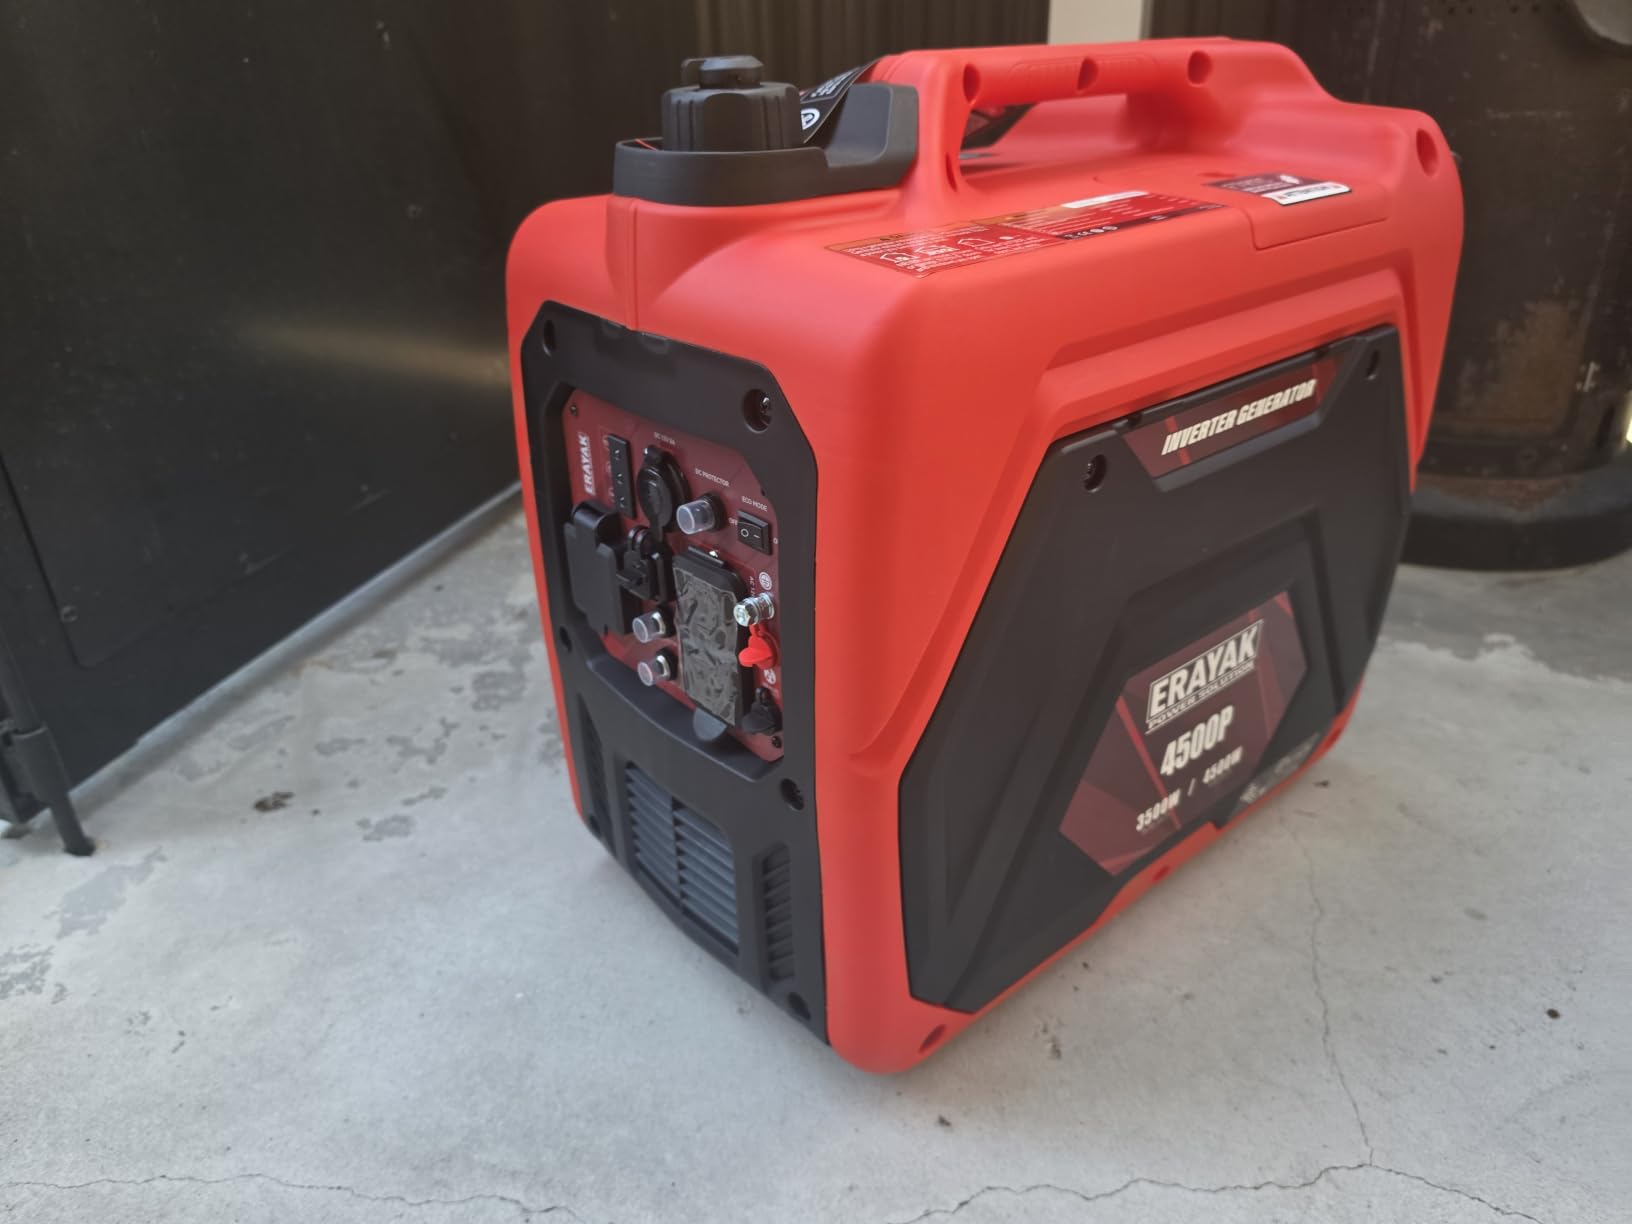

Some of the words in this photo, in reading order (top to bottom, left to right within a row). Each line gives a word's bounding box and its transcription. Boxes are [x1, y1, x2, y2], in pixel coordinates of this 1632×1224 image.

[1161, 409, 1238, 455] INVERTER
[1237, 379, 1318, 425] GENERATOR
[578, 432, 595, 495] ERAYAK
[702, 472, 730, 487] PROTECTOR
[742, 496, 752, 505] ECO
[752, 500, 768, 512] MODE
[1148, 693, 1196, 728] POWER
[1198, 660, 1255, 698] SOLUTION
[1150, 625, 1258, 716] ERAYAK
[1160, 705, 1235, 776] 4500P
[1135, 788, 1181, 831] 3500W
[1202, 747, 1243, 784] 4500W
